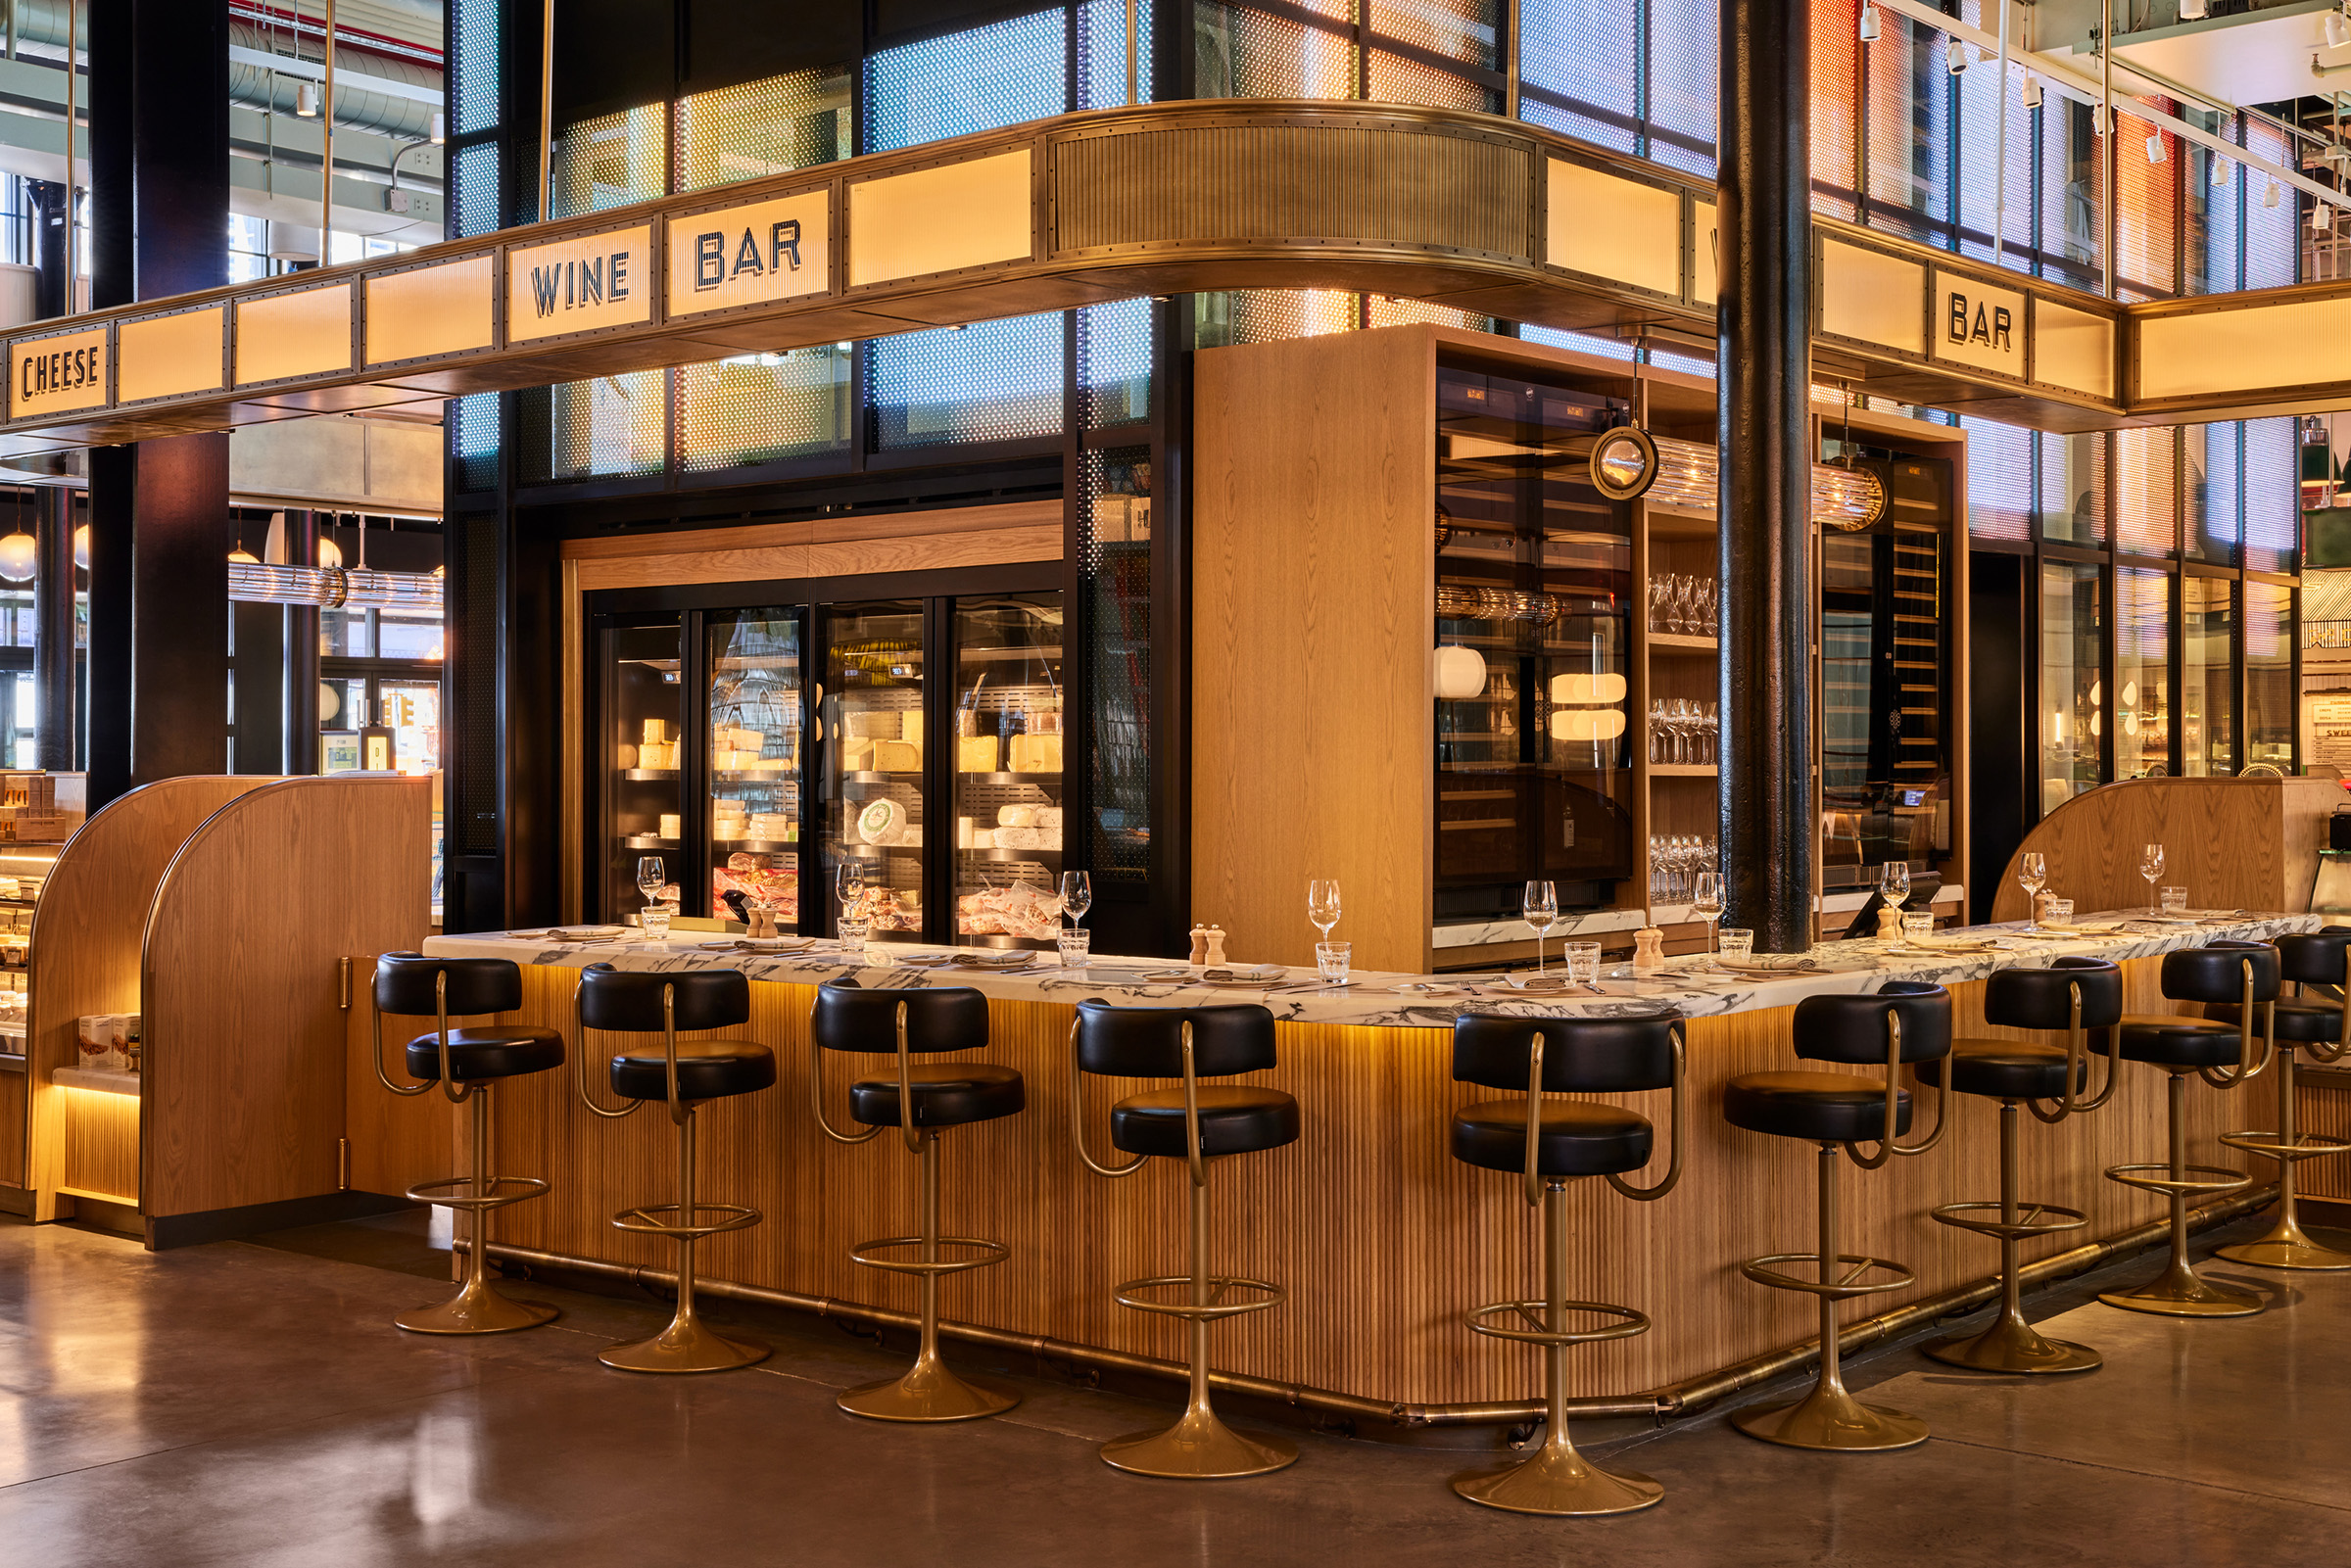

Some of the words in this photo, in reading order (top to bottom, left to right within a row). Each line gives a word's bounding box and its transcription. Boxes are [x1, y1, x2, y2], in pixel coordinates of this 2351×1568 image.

[531, 252, 629, 318] WINE
[695, 218, 801, 292] BAR
[1948, 292, 2011, 353] BAR
[22, 347, 98, 403] CHEESE
